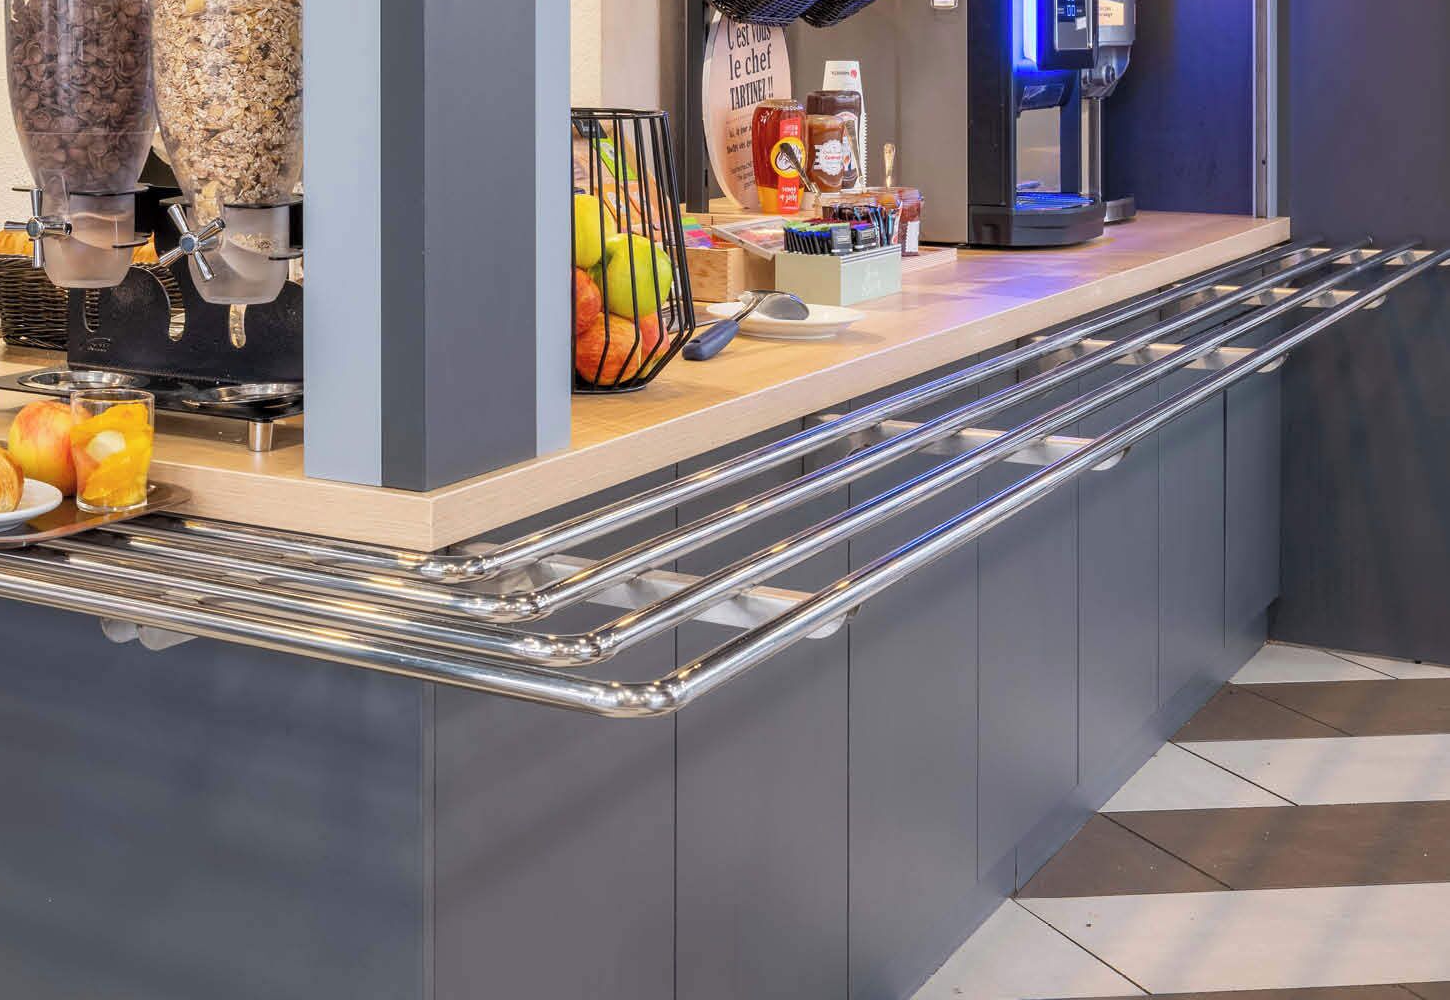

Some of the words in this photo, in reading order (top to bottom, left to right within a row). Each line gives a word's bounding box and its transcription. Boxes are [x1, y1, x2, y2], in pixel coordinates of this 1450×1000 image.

[728, 54, 741, 80] le
[745, 42, 772, 75] chef
[730, 77, 766, 111] TARTINEZ
